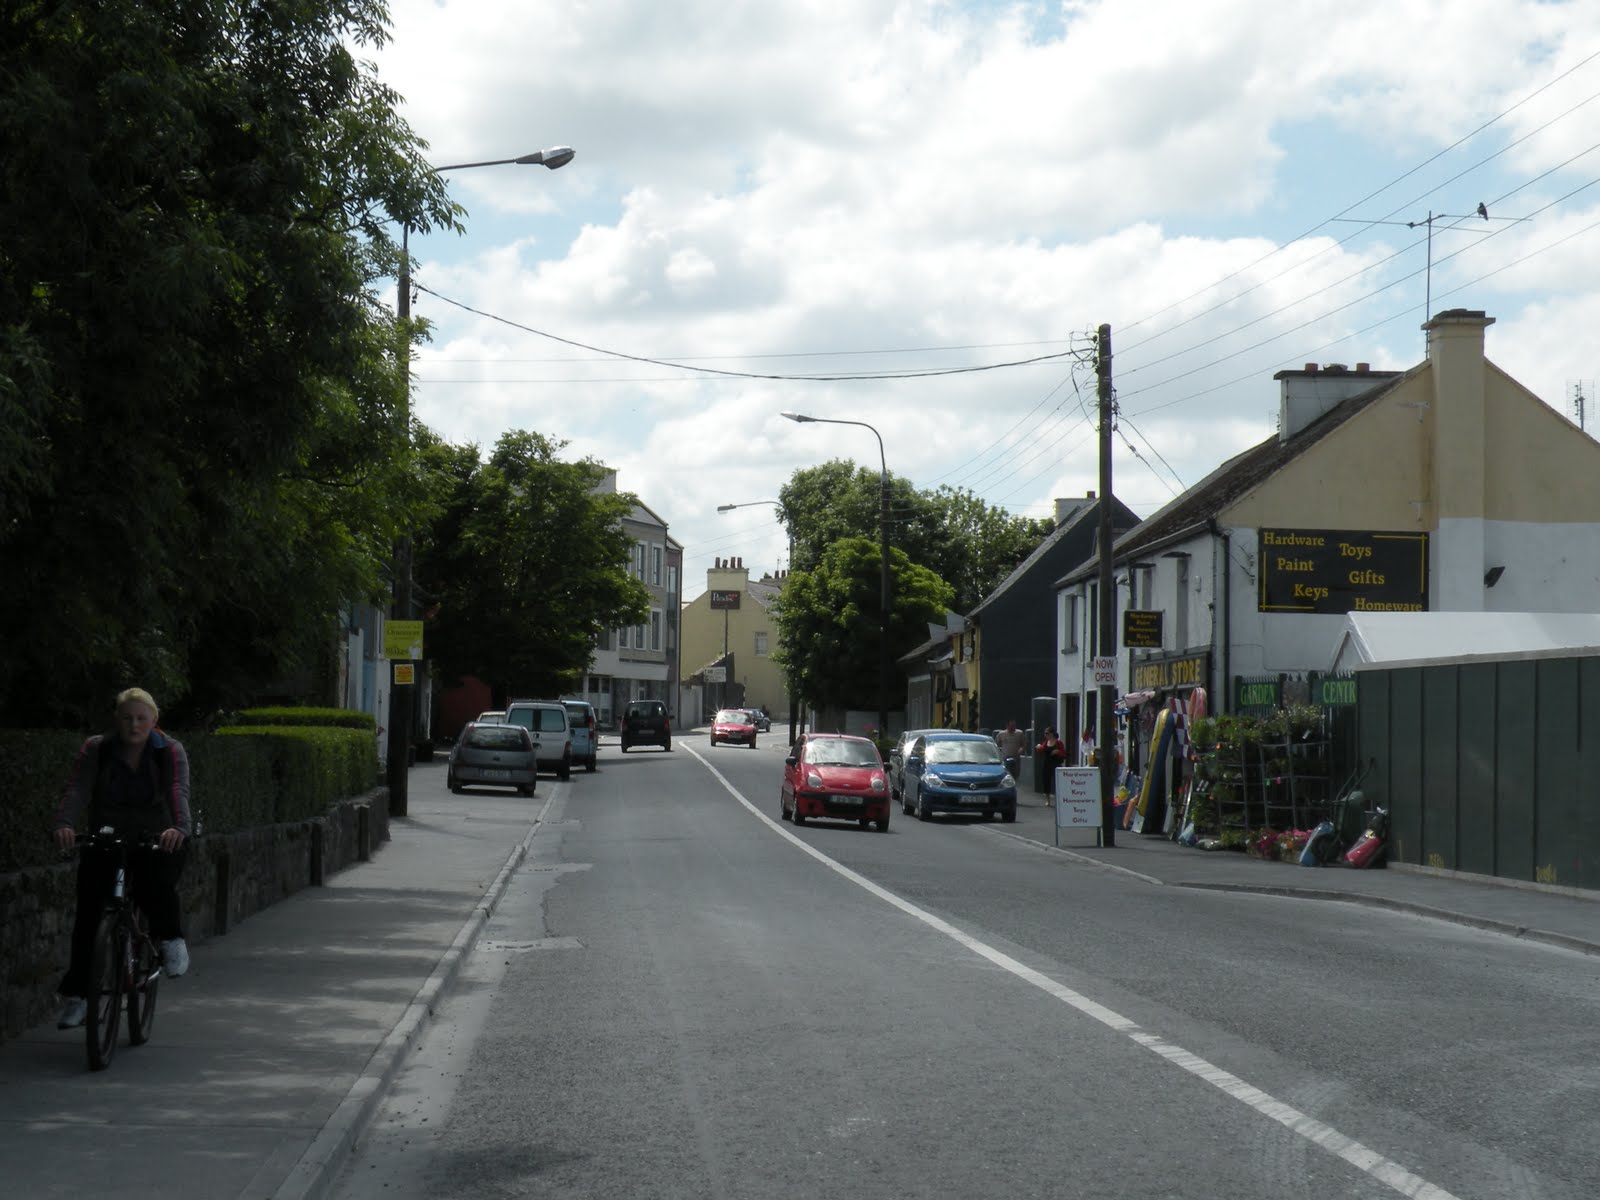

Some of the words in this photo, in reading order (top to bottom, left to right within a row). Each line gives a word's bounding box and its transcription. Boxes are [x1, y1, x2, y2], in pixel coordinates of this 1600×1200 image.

[1263, 532, 1325, 546] Hardware
[1339, 543, 1372, 560] Toys
[1277, 558, 1314, 571] Paint
[1349, 570, 1385, 585] Gifts
[1294, 584, 1329, 600] Keys
[1355, 598, 1423, 612] Homeware
[1096, 659, 1113, 668] NOW
[1095, 672, 1115, 682] OPEN
[1135, 664, 1168, 688] GENERAL
[1171, 658, 1200, 686] STORE
[1240, 683, 1275, 704] GARDEN
